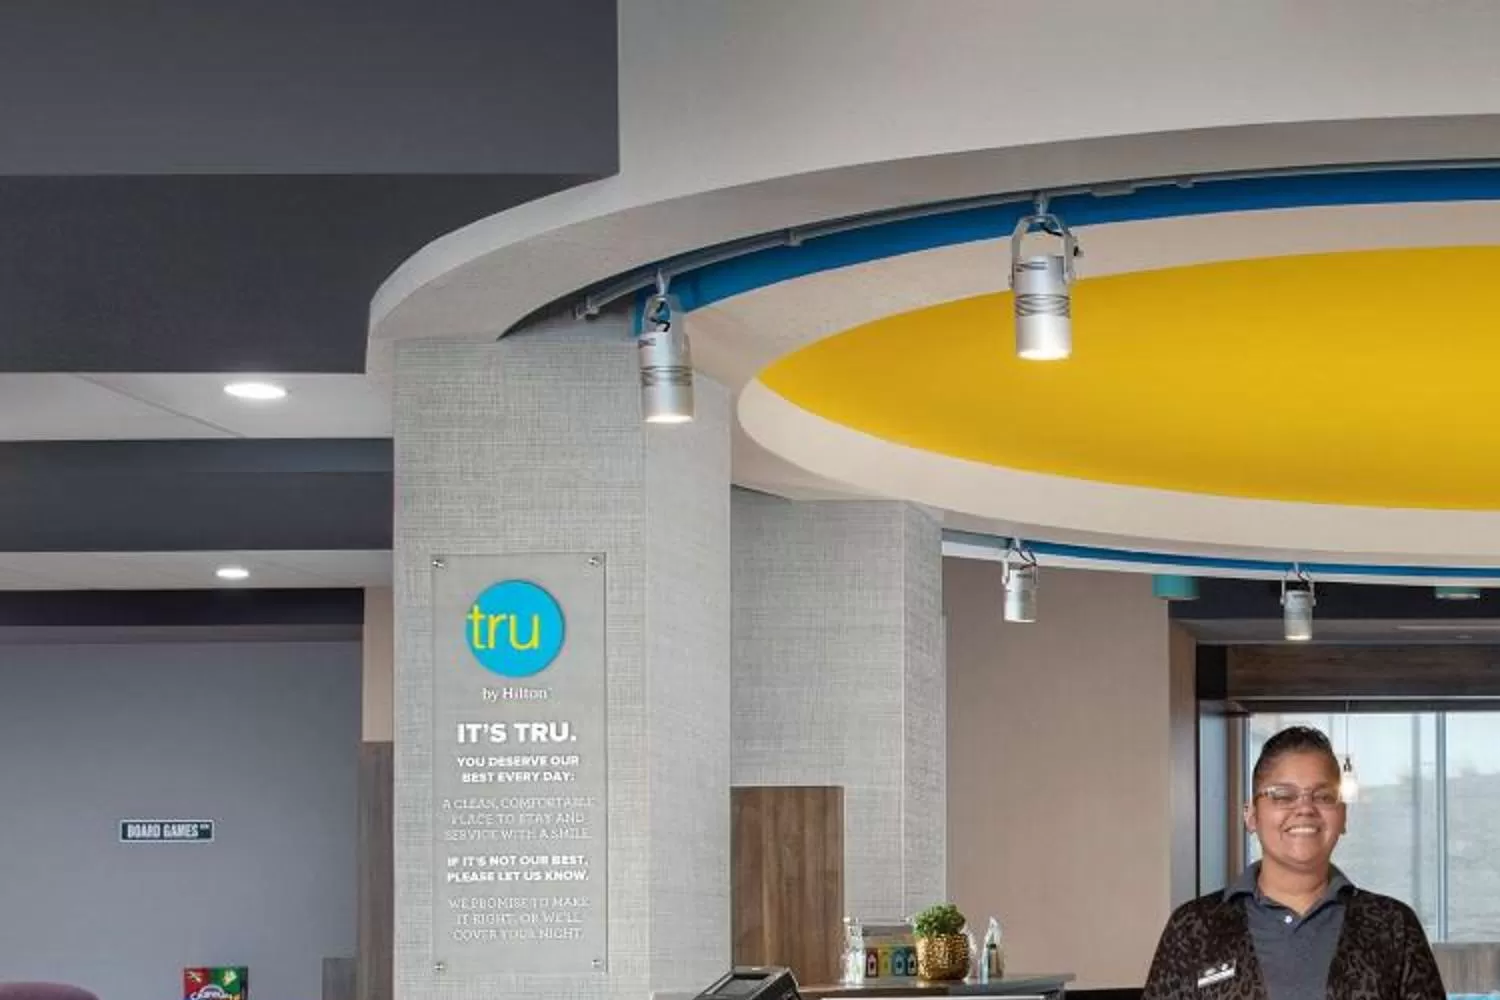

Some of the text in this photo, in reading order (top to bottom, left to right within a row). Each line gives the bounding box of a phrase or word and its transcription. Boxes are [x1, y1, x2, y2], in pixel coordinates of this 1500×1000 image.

[467, 604, 540, 650] tru
[482, 687, 547, 703] by Hilton
[457, 722, 577, 743] IT'S TRU.
[458, 755, 579, 767] YOU DESERVE OUR
[462, 772, 494, 783] BEST
[498, 771, 541, 782] EVERY
[163, 823, 198, 838] GAMES
[448, 857, 459, 867] IF
[463, 856, 486, 867] IT'S
[490, 855, 517, 866] NOT
[519, 855, 549, 866] OUR
[447, 870, 589, 883] PLEASE LET US KNOW.
